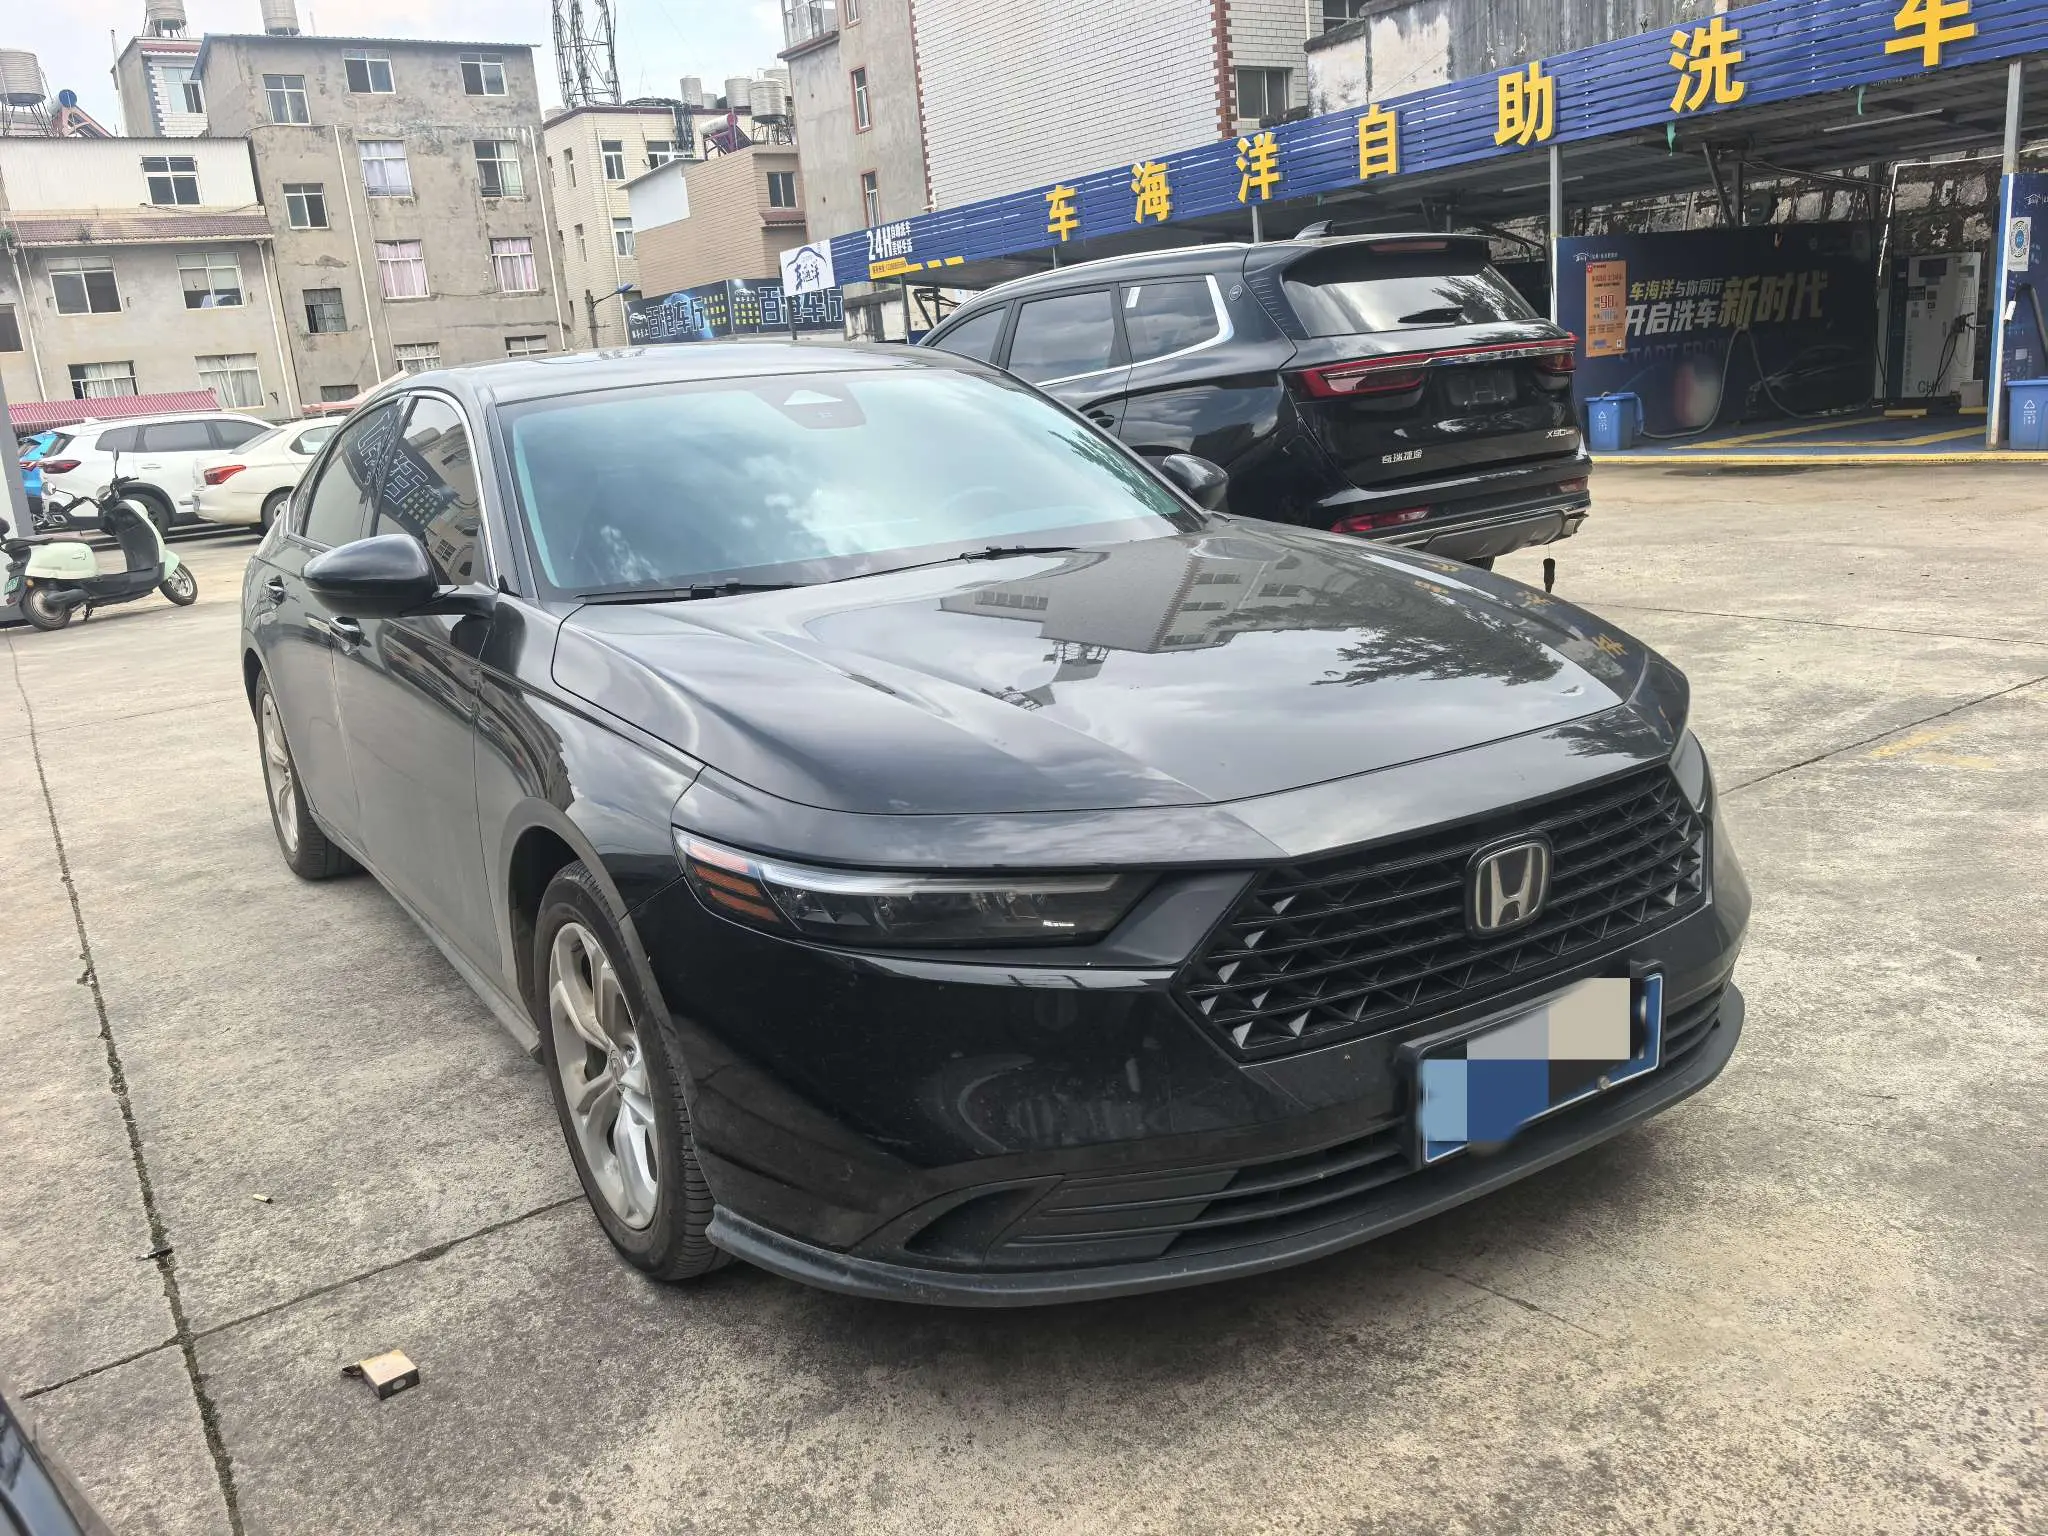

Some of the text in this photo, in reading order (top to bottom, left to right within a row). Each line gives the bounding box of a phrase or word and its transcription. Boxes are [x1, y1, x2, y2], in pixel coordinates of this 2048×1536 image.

[866, 225, 893, 261] 24H
[1629, 278, 1724, 301] 车海洋与你同行
